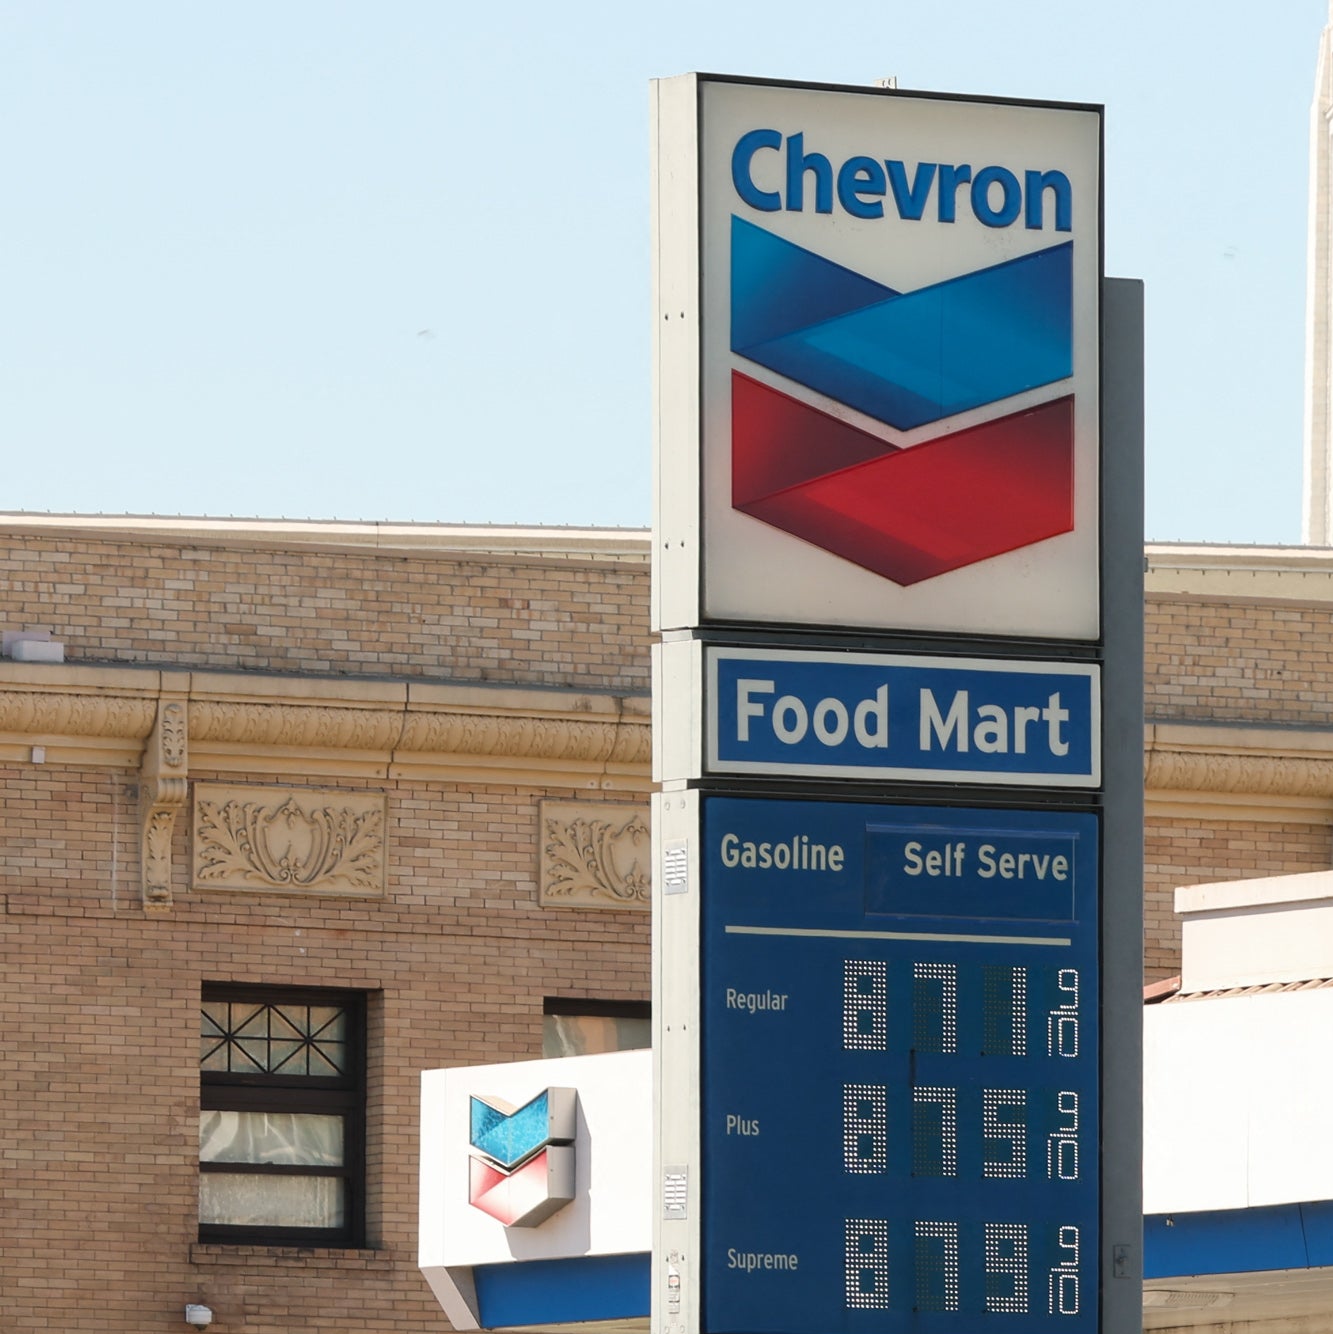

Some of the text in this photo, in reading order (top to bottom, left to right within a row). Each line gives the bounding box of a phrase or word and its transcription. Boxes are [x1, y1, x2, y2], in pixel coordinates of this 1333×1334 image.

[731, 129, 1073, 232] Chevron
[736, 678, 1070, 756] Food Mart
[721, 833, 1069, 881] Gasoline Self Serve
[725, 988, 789, 1015] Regular
[725, 1115, 760, 1136] Plus
[727, 1248, 799, 1273] Supreme
